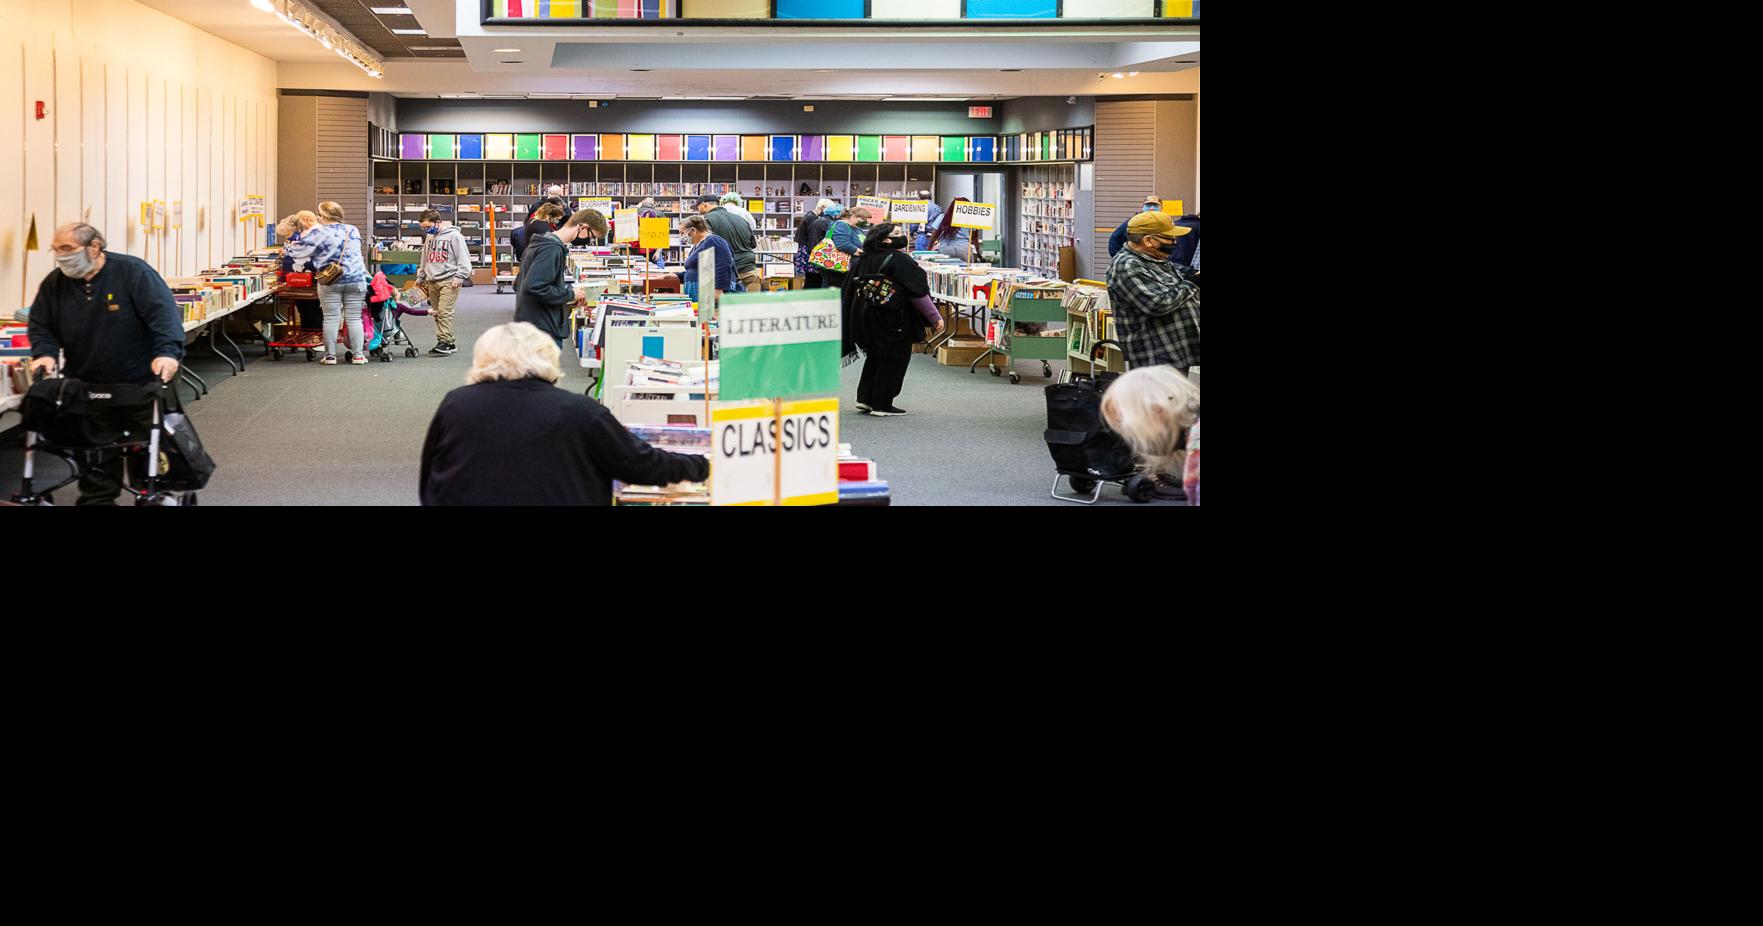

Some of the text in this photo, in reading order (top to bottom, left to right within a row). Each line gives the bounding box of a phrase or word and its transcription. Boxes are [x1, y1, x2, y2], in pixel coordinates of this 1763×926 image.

[893, 203, 926, 213] GARDENING
[956, 204, 991, 217] HOBBIES
[727, 313, 838, 335] LITERATURE
[721, 415, 831, 458] CLASSICS
